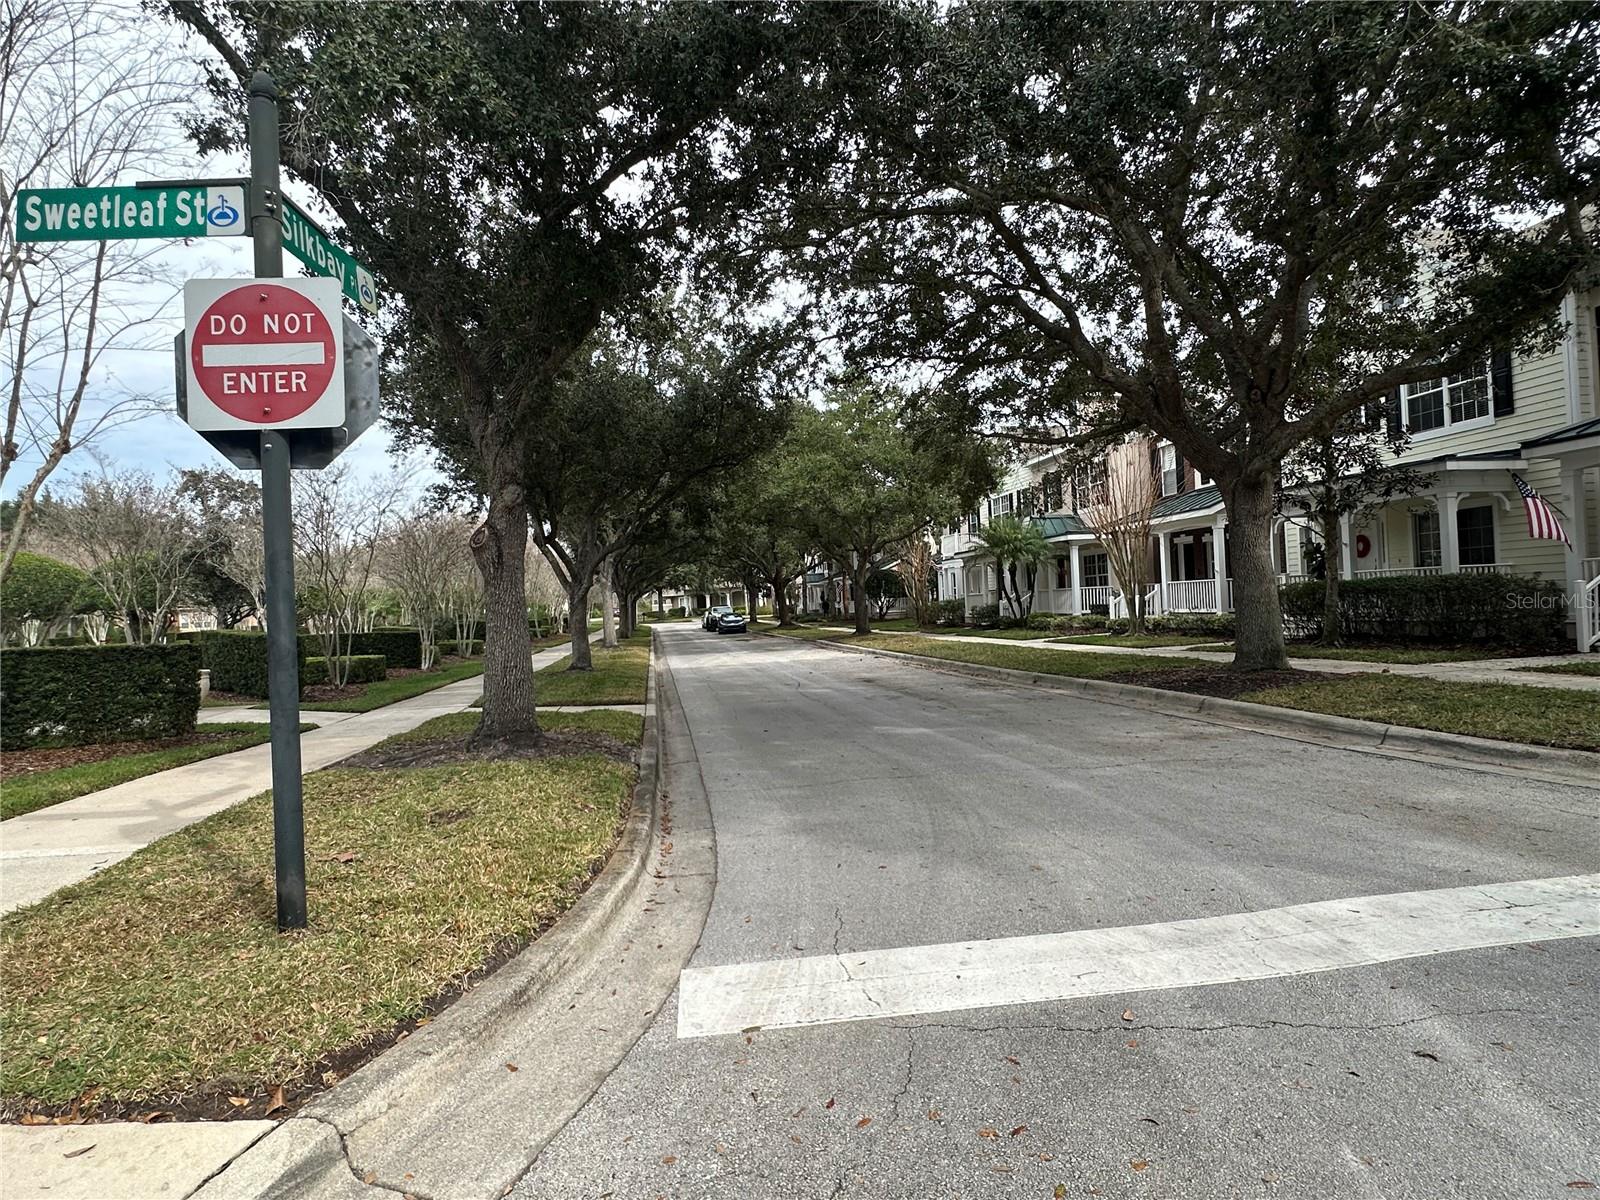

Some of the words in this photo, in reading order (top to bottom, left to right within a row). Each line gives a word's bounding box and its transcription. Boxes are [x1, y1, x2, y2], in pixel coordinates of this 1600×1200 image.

[24, 190, 168, 231] Sweetleaf
[176, 190, 206, 226] St
[281, 204, 346, 290] Silkbay
[210, 314, 247, 336] DO
[263, 312, 316, 335] NOT
[223, 371, 308, 395] ENTER
